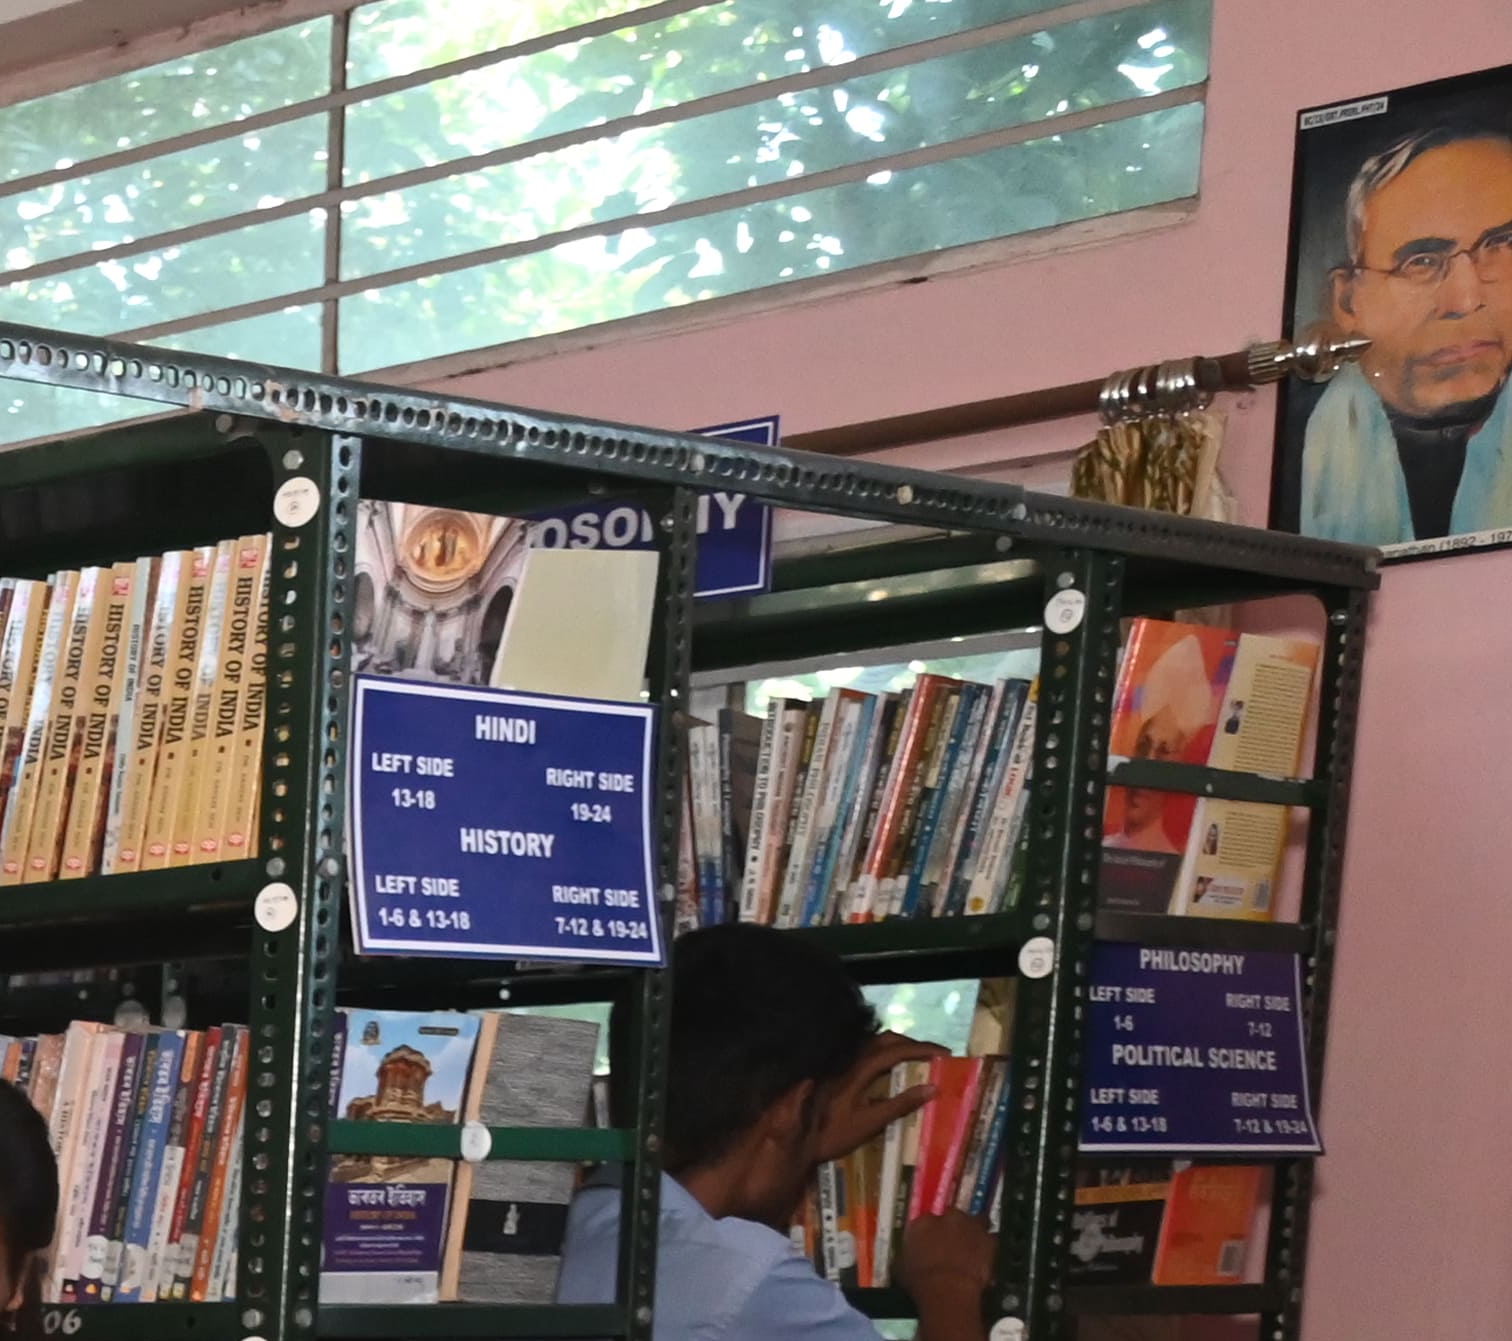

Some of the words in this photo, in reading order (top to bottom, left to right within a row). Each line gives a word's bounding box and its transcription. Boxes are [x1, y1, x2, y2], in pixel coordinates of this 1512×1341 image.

[476, 715, 535, 744] HINDI
[372, 753, 412, 773] LEFT
[417, 756, 453, 777] SIDE
[546, 768, 595, 788] RIGHT
[599, 773, 634, 792] SIDE
[392, 788, 435, 809] 13-18
[571, 803, 611, 822] 19-24
[461, 828, 554, 857] HISTORY
[376, 875, 417, 894] LEFT
[421, 877, 459, 897] SIDE
[552, 885, 600, 905] RIGHT
[604, 889, 639, 908] SIDE
[379, 908, 404, 926] 1-6
[409, 909, 421, 927] &
[426, 910, 470, 929] 13-18
[555, 917, 588, 935] 7-12
[592, 919, 604, 936] &
[608, 921, 647, 938] 19-24
[1140, 949, 1244, 974] PHILOSOPHY
[1090, 986, 1122, 1001] LEFT
[1126, 988, 1155, 1003] SIDE
[1226, 993, 1261, 1008] RIGHT
[1264, 996, 1290, 1011] SIDE
[1114, 1015, 1133, 1031] 1-6
[1248, 1022, 1272, 1037] 7-12
[1113, 1044, 1204, 1067] POLITICAL
[1208, 1048, 1276, 1070] SCIENCE
[1091, 1088, 1125, 1104] LEFT
[1129, 1089, 1159, 1104] SIDE
[1232, 1092, 1267, 1107] RIGHT
[1271, 1094, 1297, 1108] SIDE
[1092, 1116, 1113, 1131] 1-6
[1117, 1116, 1127, 1131] &
[1131, 1117, 1167, 1132] 13-18
